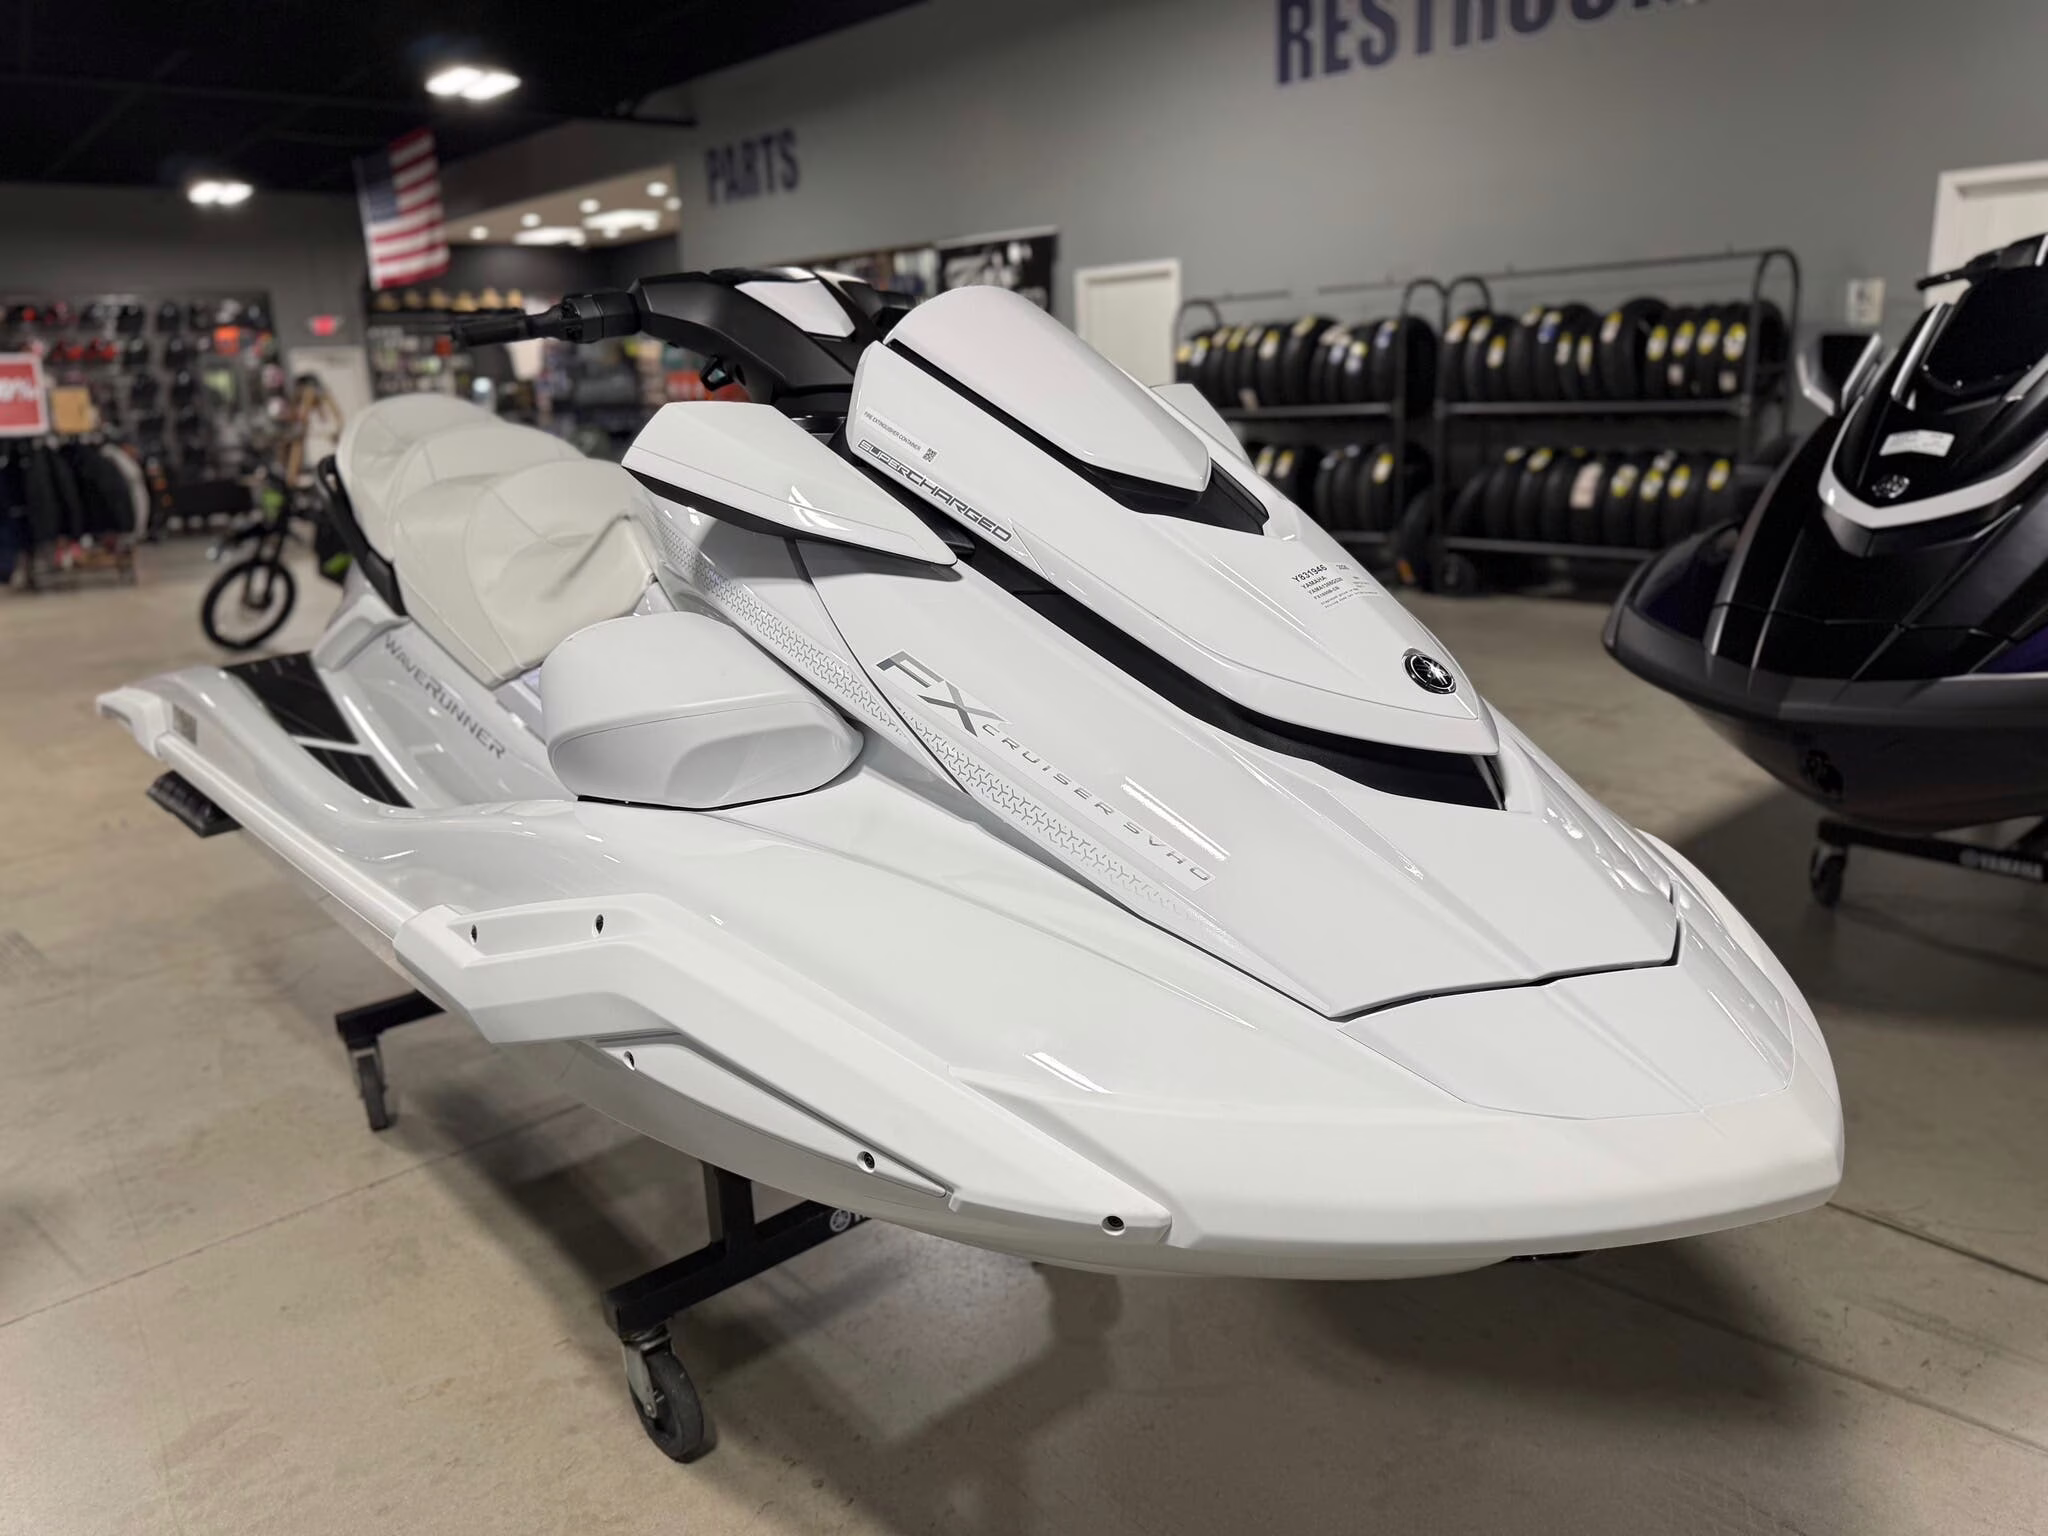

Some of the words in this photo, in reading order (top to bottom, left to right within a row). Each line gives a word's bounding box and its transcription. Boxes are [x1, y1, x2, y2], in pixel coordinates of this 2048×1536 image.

[705, 127, 799, 204] PARTS
[858, 440, 1012, 542] SUPERCHARGED
[1301, 575, 1326, 589] YAMAHA
[385, 633, 506, 759] WAVERUNNER
[876, 650, 1007, 737] FX
[981, 723, 1116, 816] CRUISER
[1122, 821, 1209, 881] SVHO
